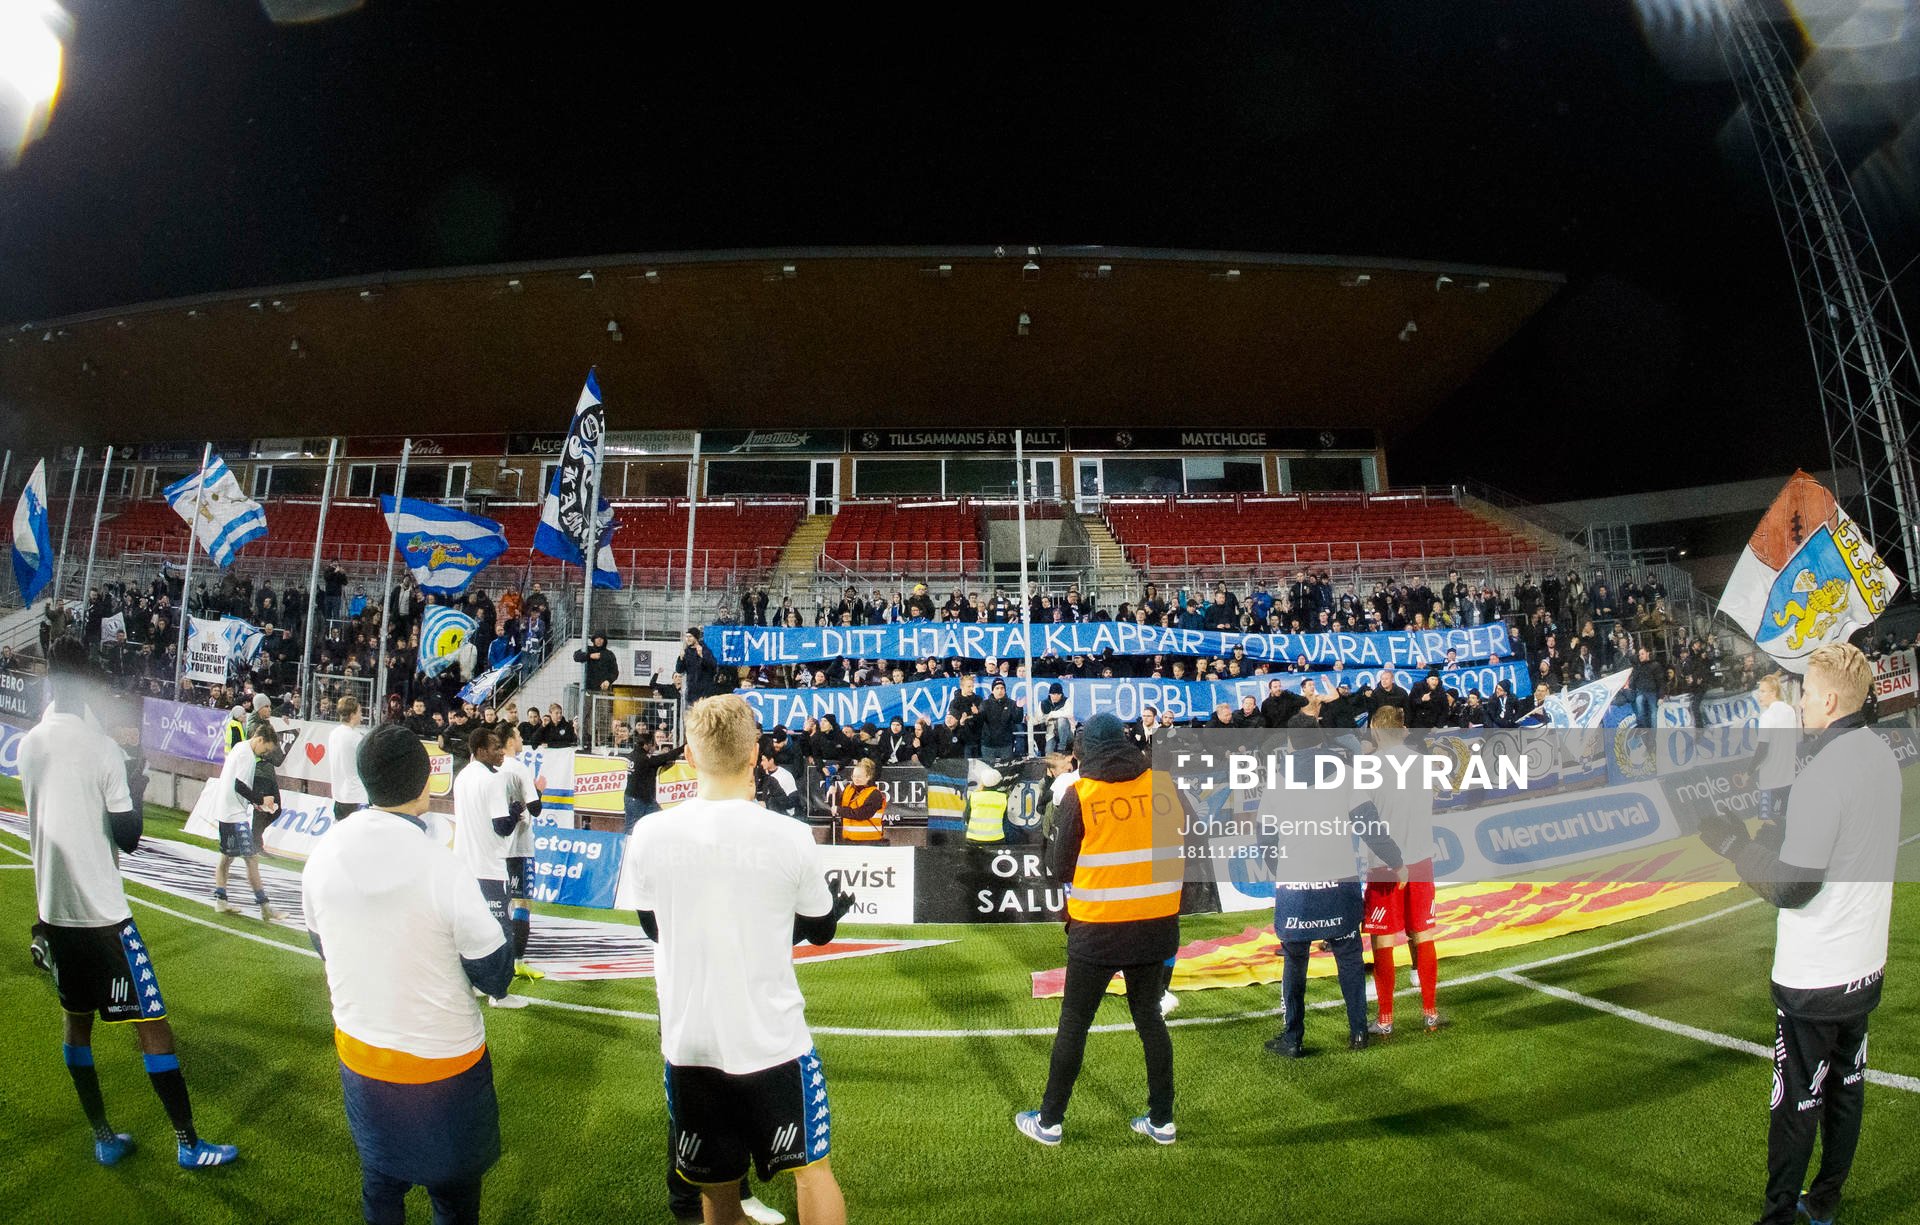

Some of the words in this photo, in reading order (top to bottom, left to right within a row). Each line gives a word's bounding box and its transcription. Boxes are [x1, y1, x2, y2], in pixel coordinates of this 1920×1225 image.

[401, 438, 444, 455] Linde
[532, 438, 567, 452] Acces
[889, 433, 984, 446] TILLSAMMANS
[987, 430, 1005, 444] ÄR
[1025, 432, 1060, 444] ALLT.
[1182, 432, 1267, 446] MATCHLOGE
[201, 643, 218, 653] WE'RE
[822, 629, 887, 658] DITT
[900, 624, 1027, 658] HJÄRTA
[1044, 622, 1205, 654] KLAPPAR
[1388, 624, 1508, 665] FÄRGER
[191, 651, 226, 663] LEGENDARY
[1877, 653, 1910, 675] KEL
[191, 661, 213, 673] YOU'RE
[213, 664, 225, 675] NOT
[0, 674, 24, 692] EBRO
[1877, 673, 1912, 696] SSAN
[0, 694, 26, 713] UHALL
[748, 689, 885, 728] STANNA
[1664, 695, 1761, 727] SETION
[161, 717, 197, 735] DAHL
[1668, 717, 1760, 766] OSLO
[1893, 737, 1918, 761] and
[575, 773, 626, 785] RVBRÖD
[658, 782, 698, 794] KORVB
[671, 791, 698, 800] BAG
[1676, 776, 1731, 804] make
[1089, 791, 1172, 827] FOTO
[1489, 811, 1588, 852] Mercuri
[1591, 800, 1649, 834] Urval
[535, 835, 602, 860] etong
[535, 861, 583, 879] sad
[824, 863, 896, 893] qvist
[977, 888, 1065, 914] SALU
[1843, 1073, 1862, 1086] NRC
[1797, 1098, 1816, 1112] NRC
